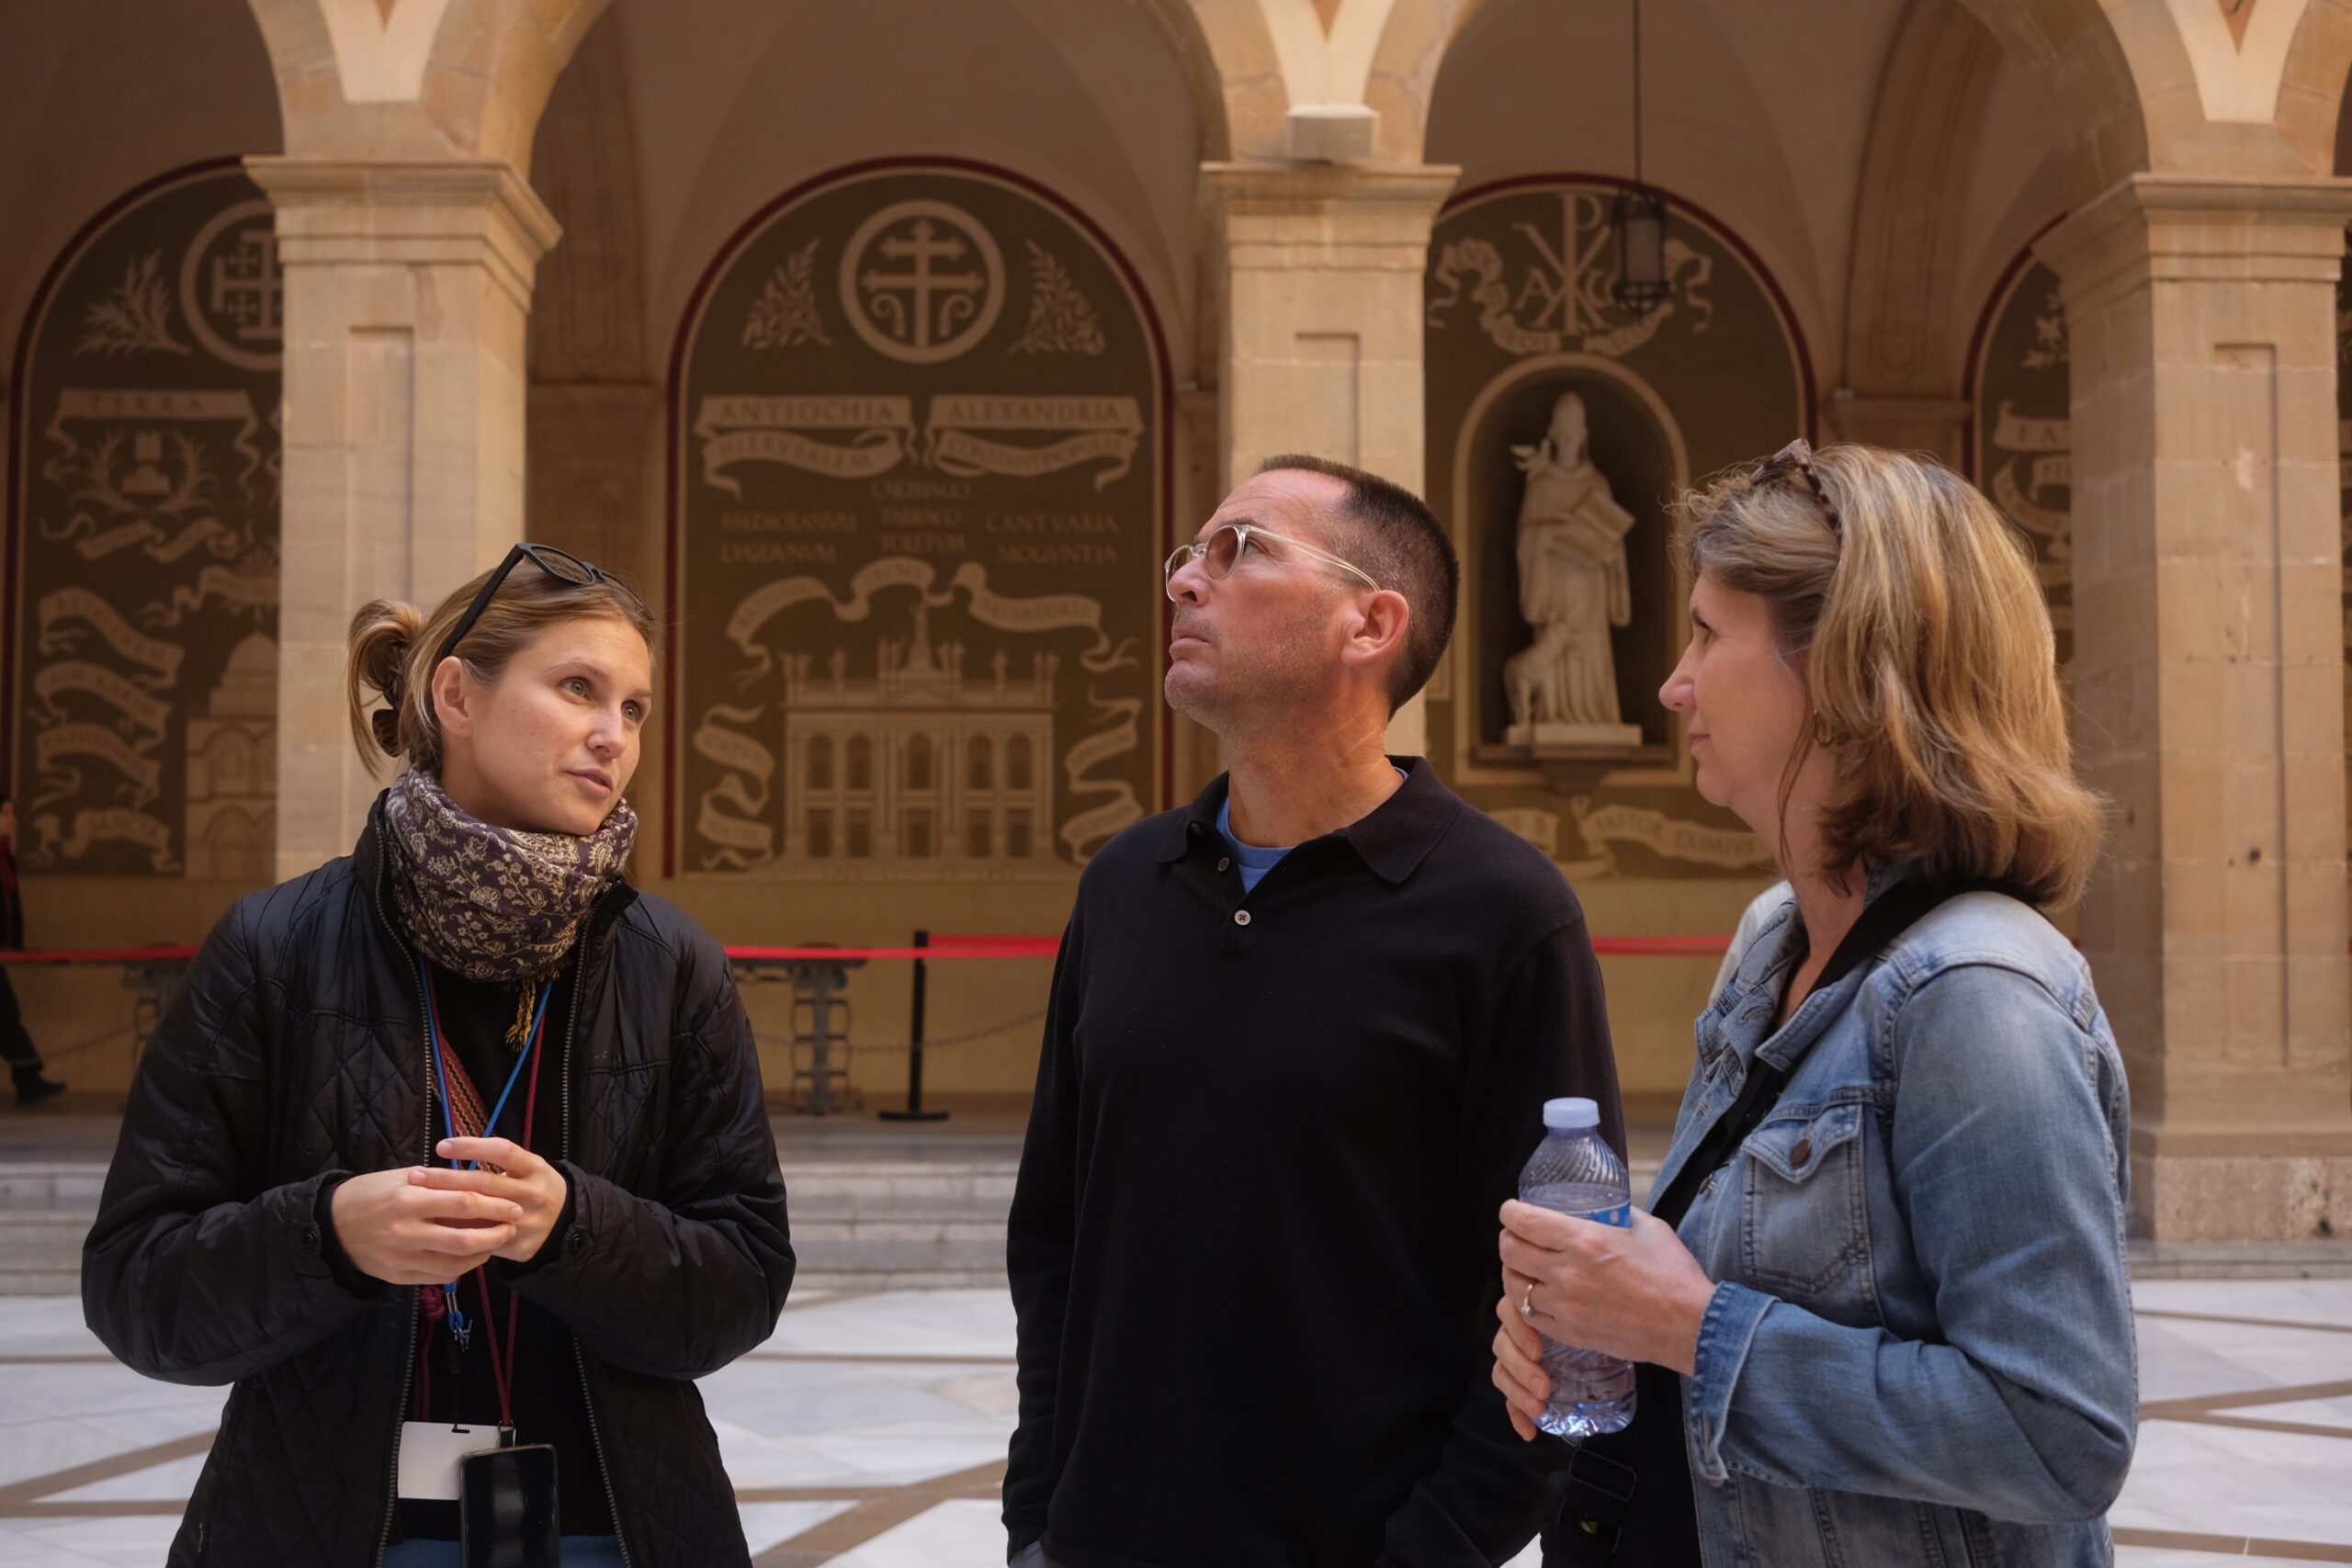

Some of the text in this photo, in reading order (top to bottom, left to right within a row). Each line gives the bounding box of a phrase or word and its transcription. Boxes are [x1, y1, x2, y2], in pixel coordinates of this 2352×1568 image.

[88, 395, 203, 415] TERRA
[718, 401, 895, 423] ANTIOCHIA
[948, 400, 1122, 423] ALEXANDRIA
[870, 479, 972, 501] CARTHAGO
[983, 511, 1121, 535] CANTVARIA
[994, 542, 1120, 565] MOGVNTIA
[1595, 812, 1665, 840] PASTOR
